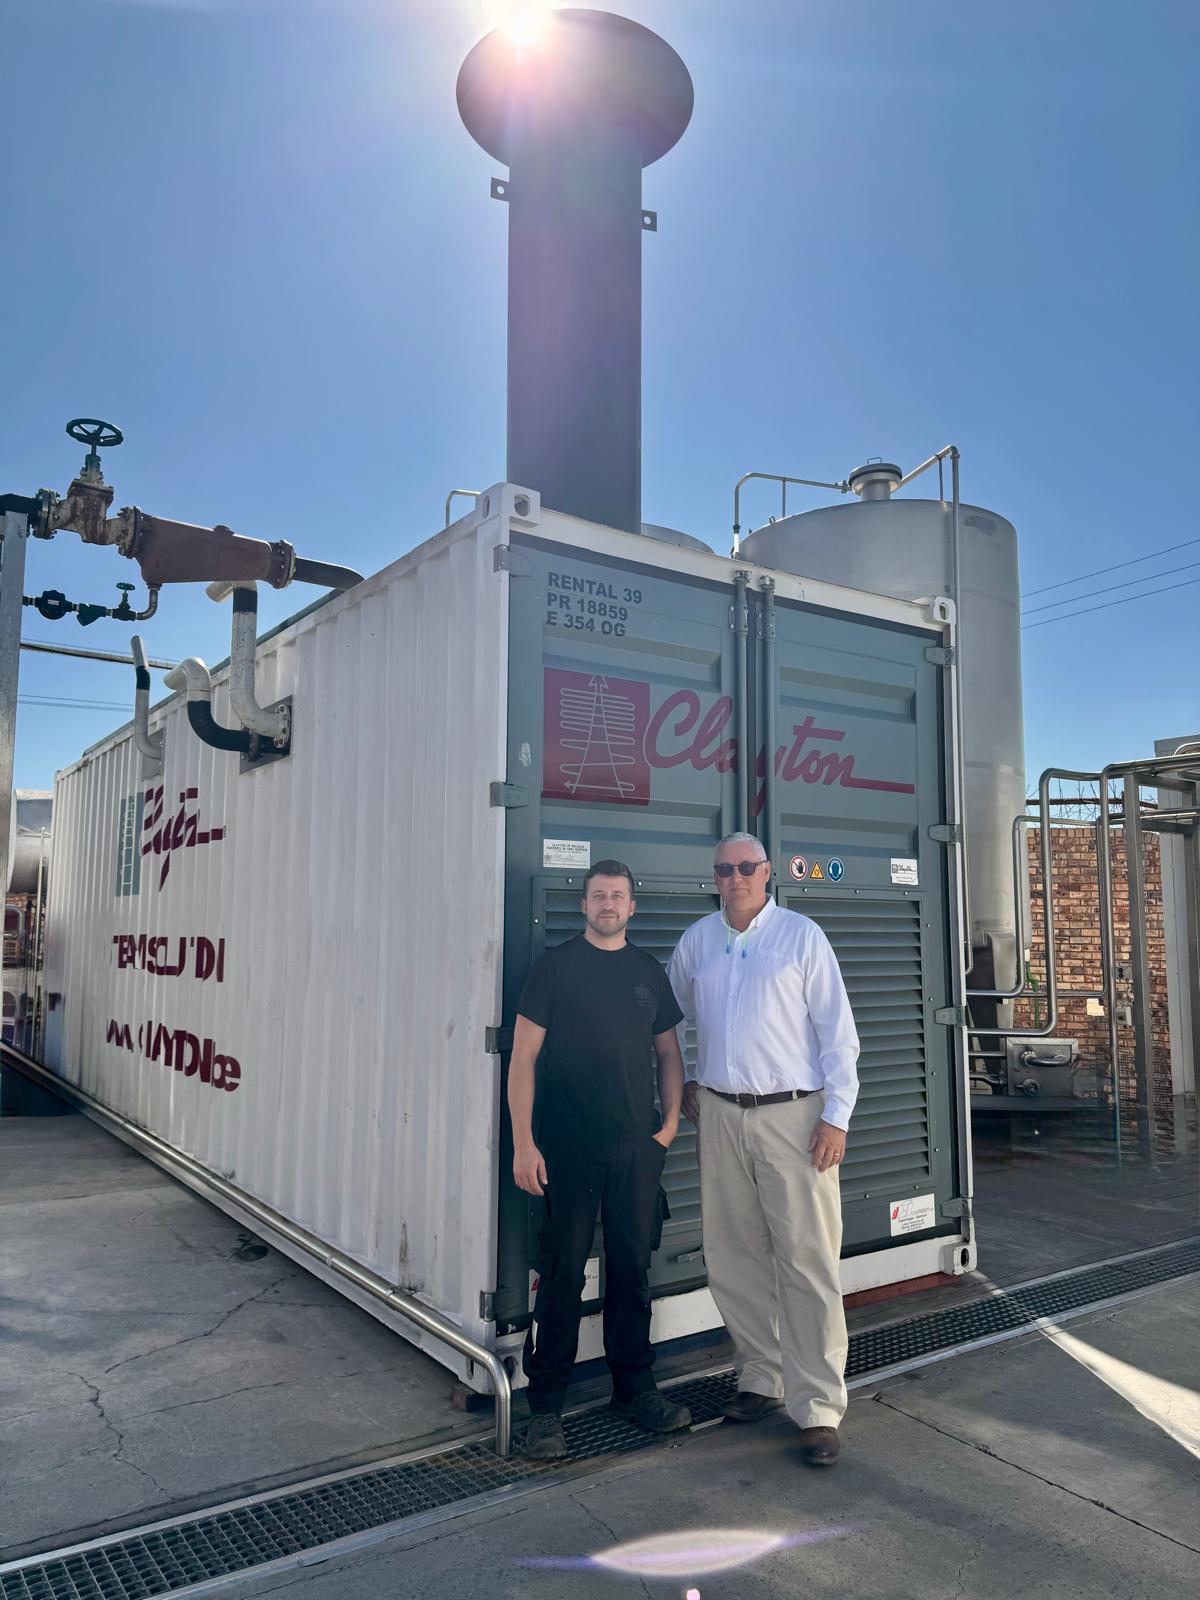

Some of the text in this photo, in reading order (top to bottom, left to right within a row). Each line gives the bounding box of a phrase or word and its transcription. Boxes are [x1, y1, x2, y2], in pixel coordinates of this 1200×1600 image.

[548, 572, 642, 604] RENTAL 39
[547, 592, 628, 621] PR 18859
[546, 610, 626, 637] E 354 OG
[643, 689, 915, 817] Clayton
